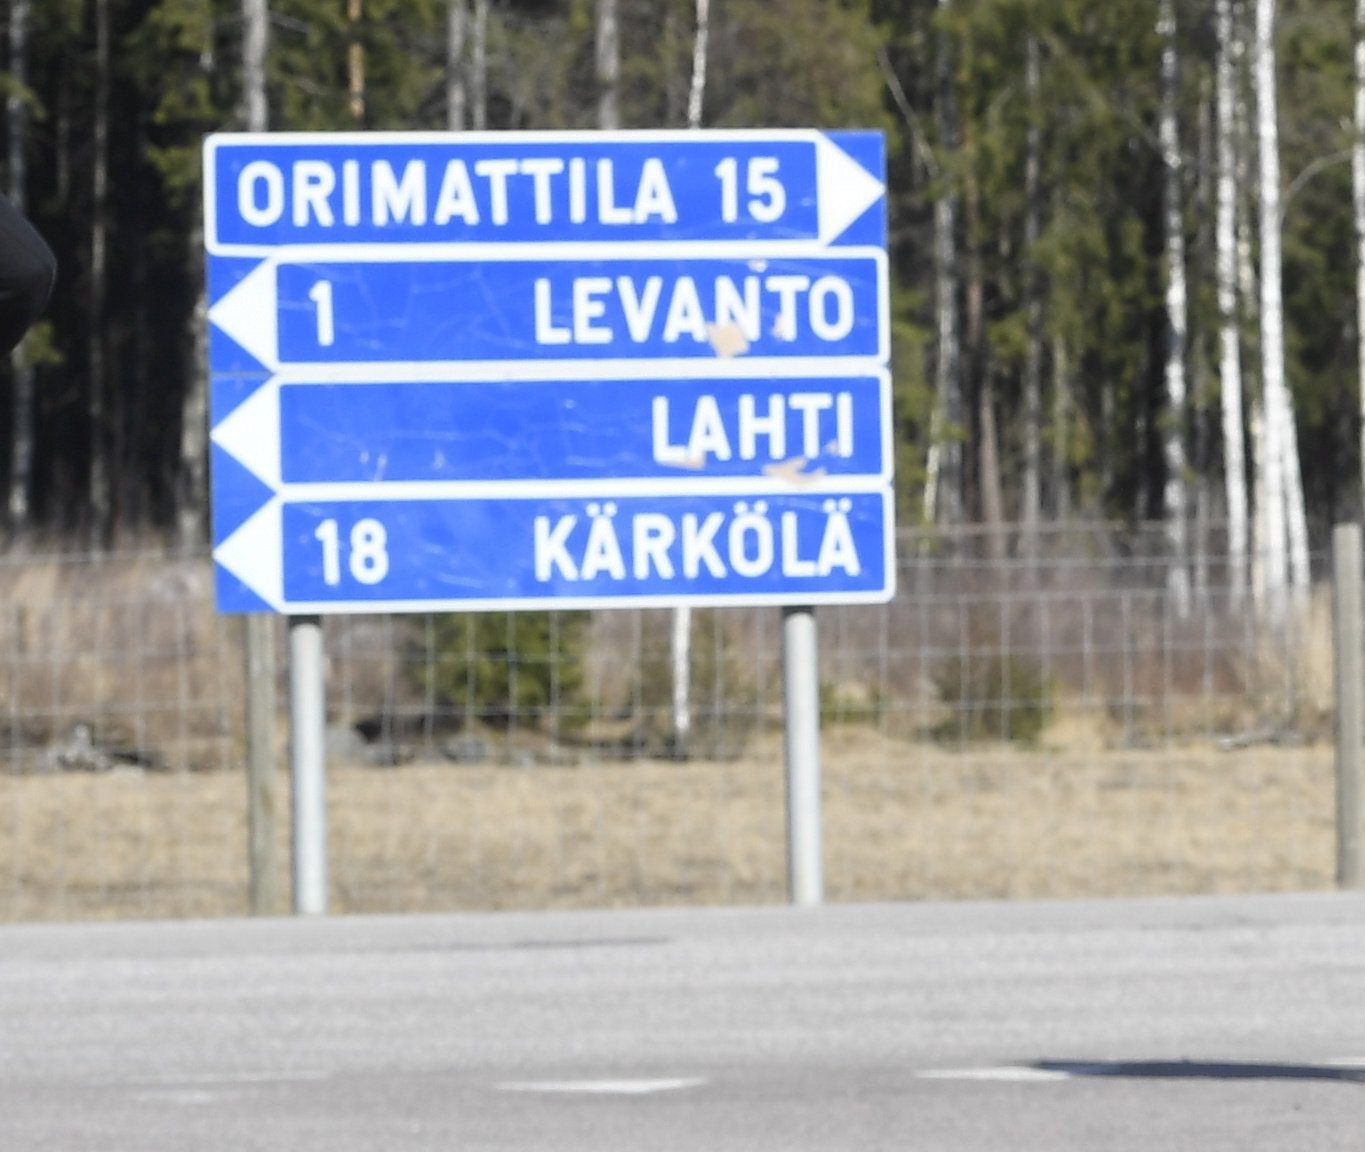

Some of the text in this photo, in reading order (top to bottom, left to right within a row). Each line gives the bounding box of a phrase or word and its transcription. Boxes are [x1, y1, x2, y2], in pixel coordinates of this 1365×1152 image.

[237, 156, 787, 228] ORIMATTILA 15
[308, 275, 855, 346] 1 LEVANTO
[652, 391, 854, 464] LAHTI
[314, 498, 862, 586] 18 KÄRKÖLÄ
